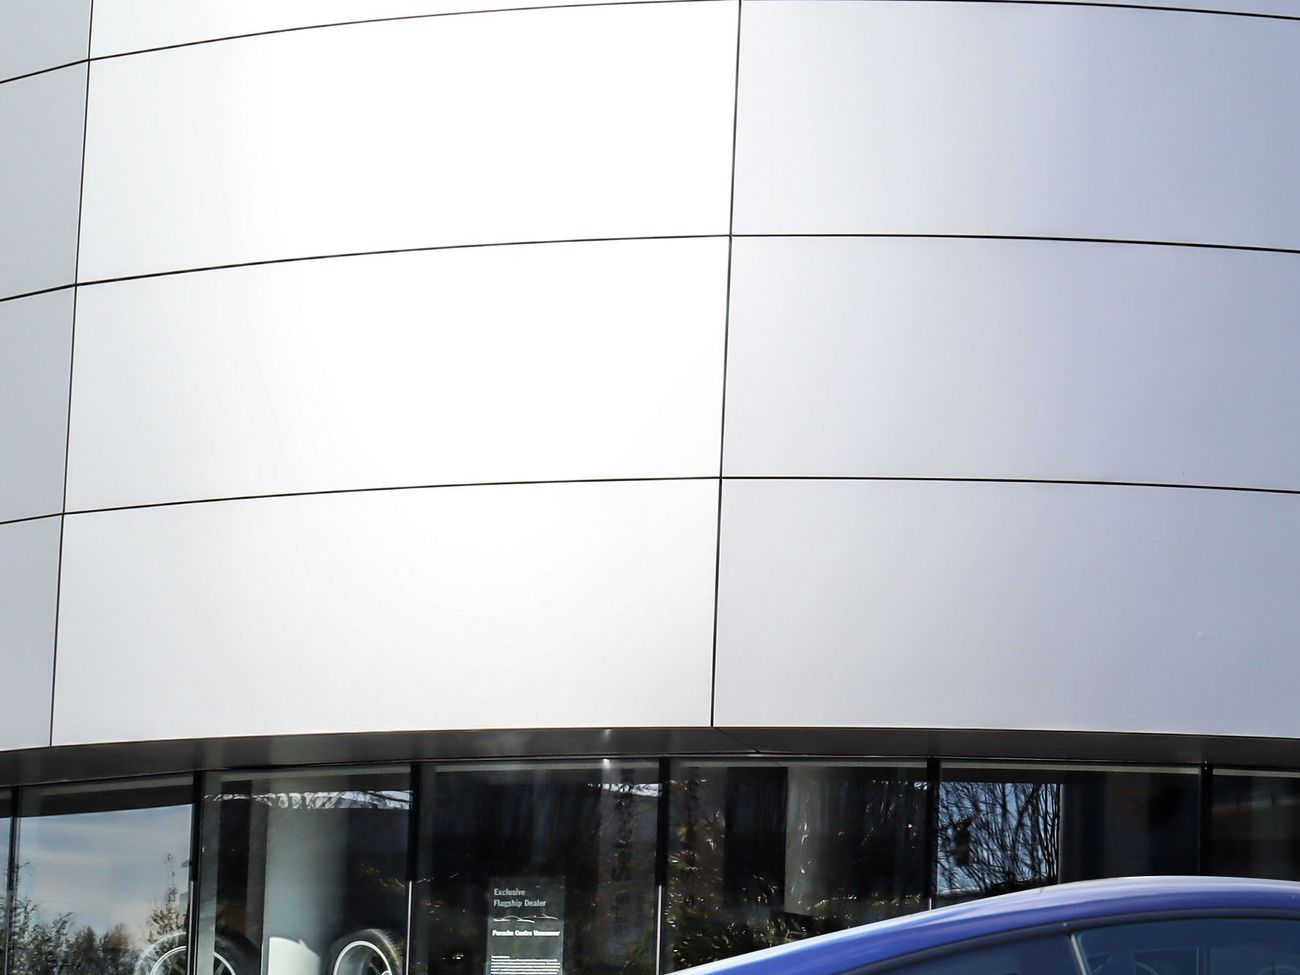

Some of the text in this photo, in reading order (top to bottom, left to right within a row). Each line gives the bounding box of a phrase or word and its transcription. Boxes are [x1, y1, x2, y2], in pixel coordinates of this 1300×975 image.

[493, 888, 526, 896] Exclusive
[493, 899, 546, 908] Flagship Dealer
